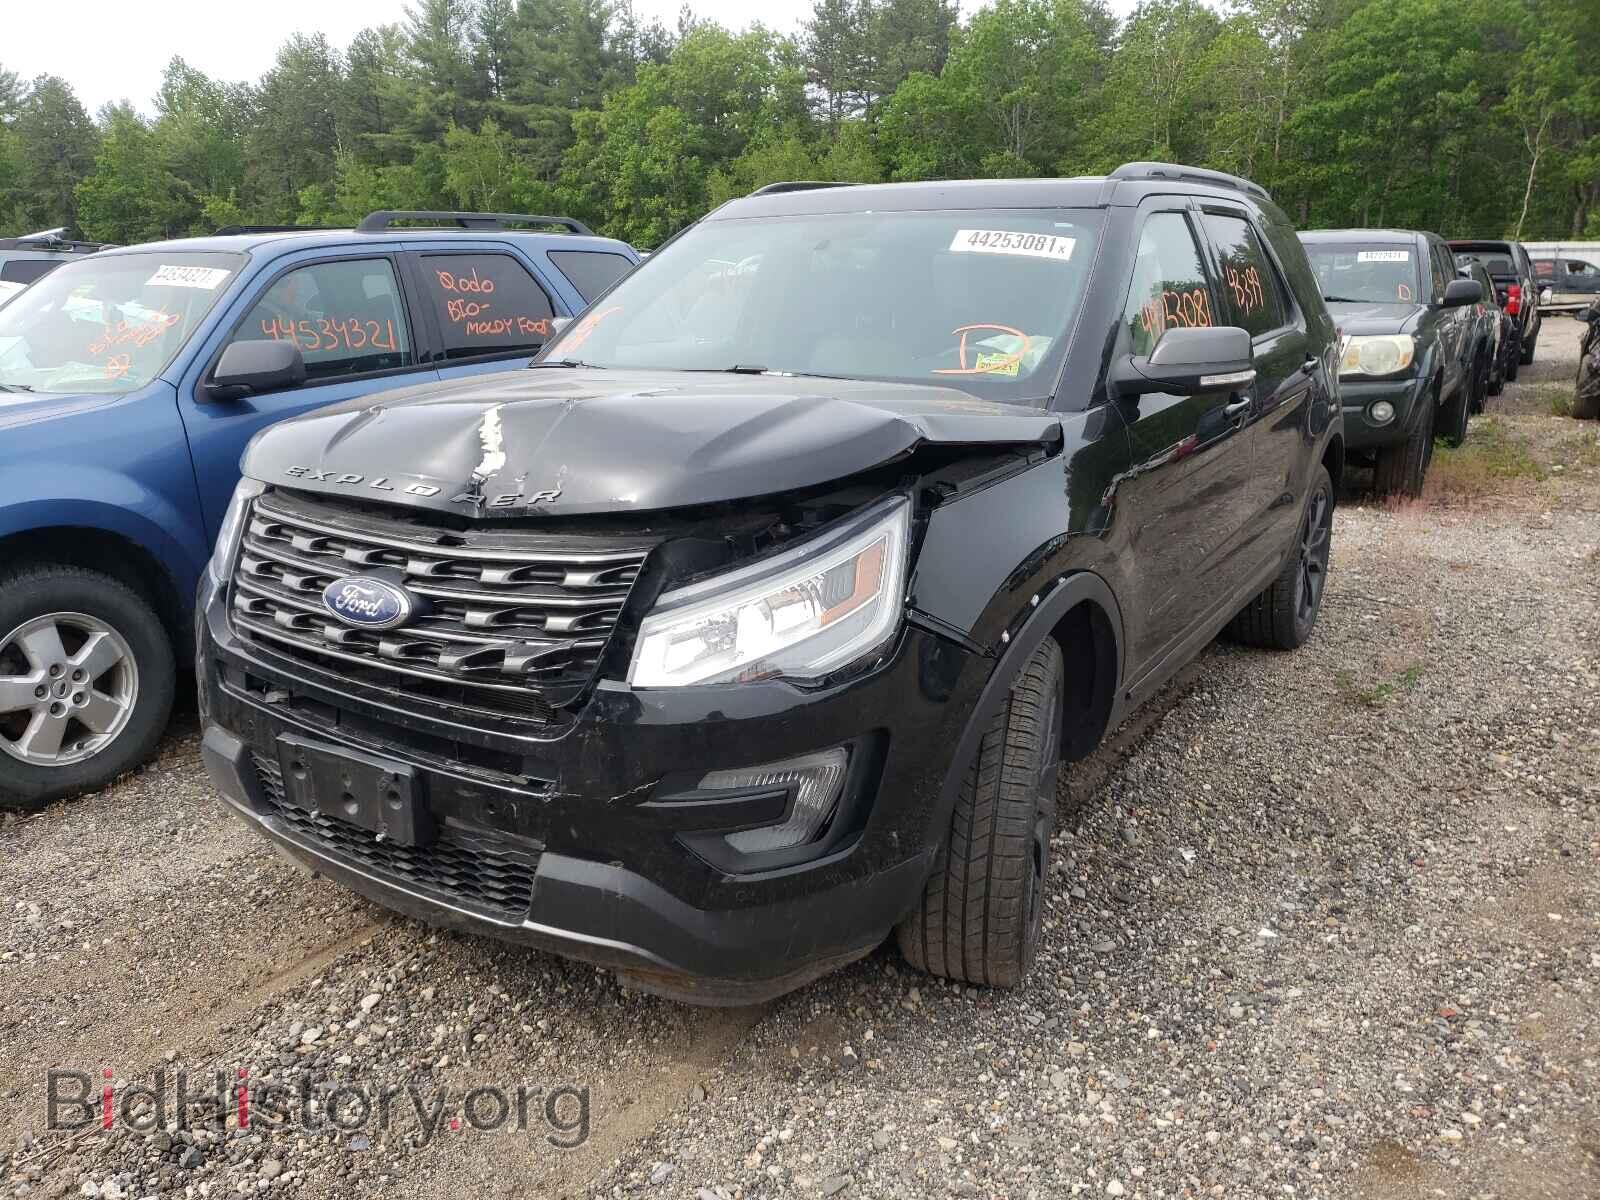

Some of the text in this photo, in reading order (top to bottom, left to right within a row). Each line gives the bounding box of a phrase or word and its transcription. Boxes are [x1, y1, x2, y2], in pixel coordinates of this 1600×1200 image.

[966, 231, 1057, 253] 44253081
[261, 317, 397, 352] 44534321
[335, 584, 385, 617] Ford
